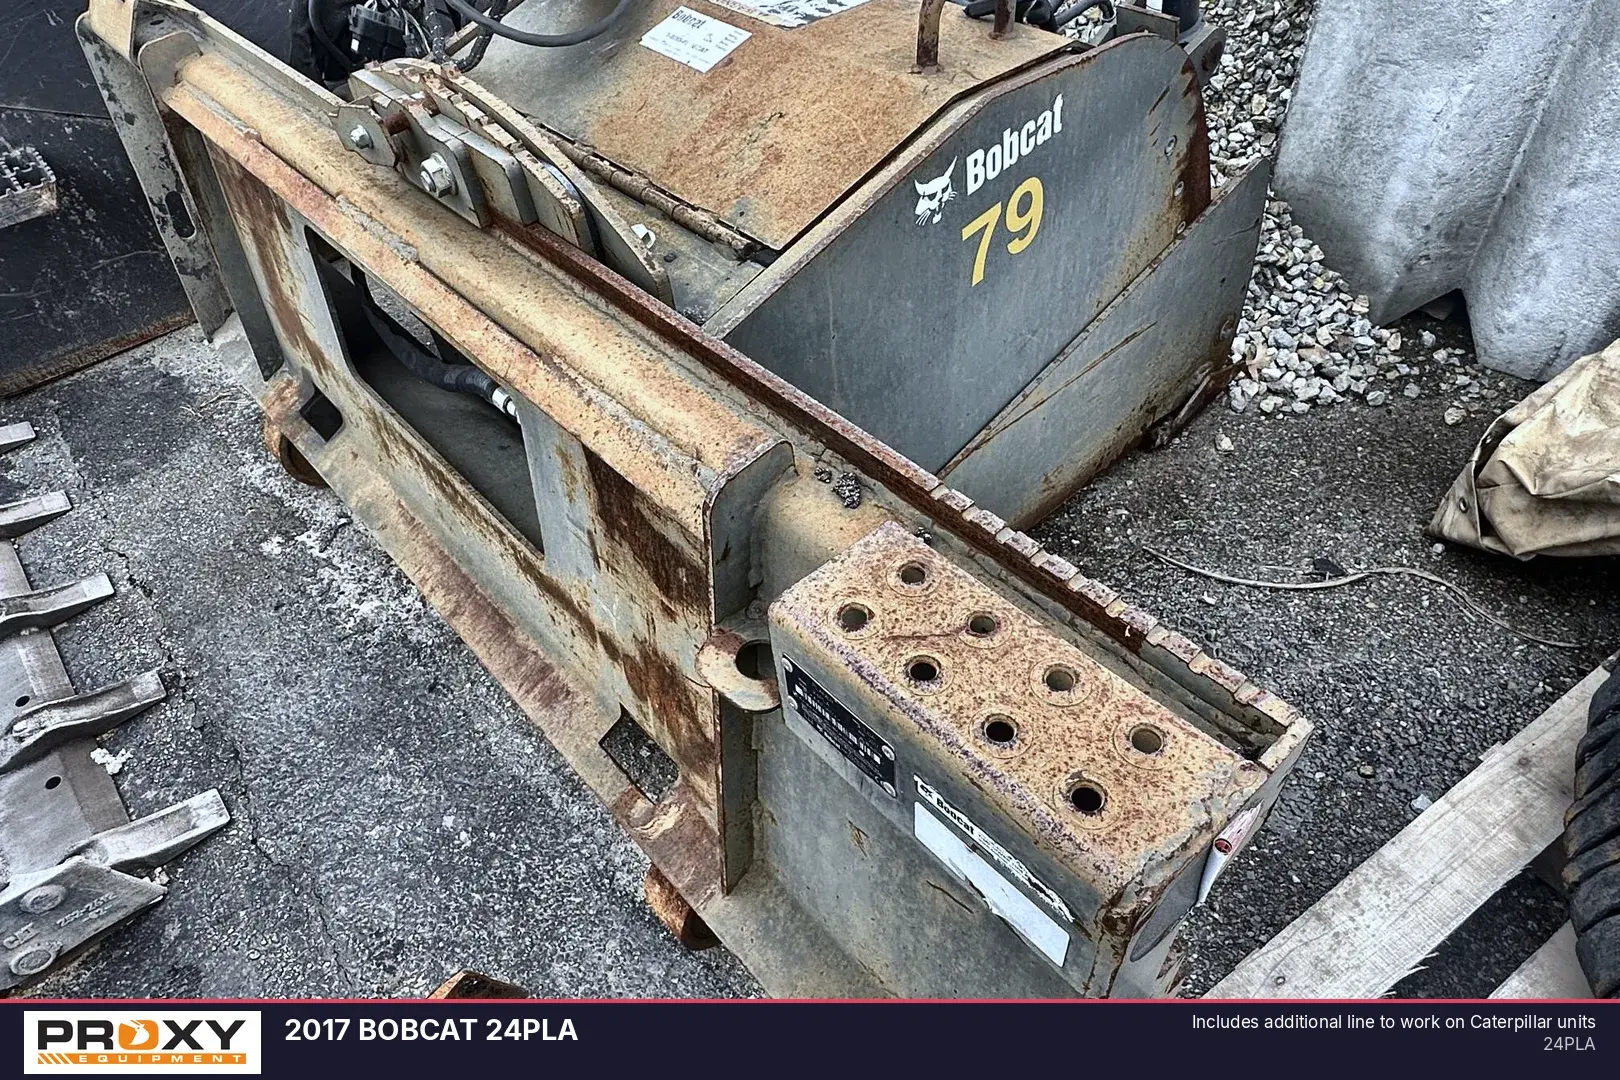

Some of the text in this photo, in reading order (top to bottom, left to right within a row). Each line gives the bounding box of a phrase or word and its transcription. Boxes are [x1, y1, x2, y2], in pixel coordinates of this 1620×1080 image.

[671, 9, 707, 30] Bobcat
[965, 92, 1065, 197] Bobcat
[961, 176, 1044, 287] 79
